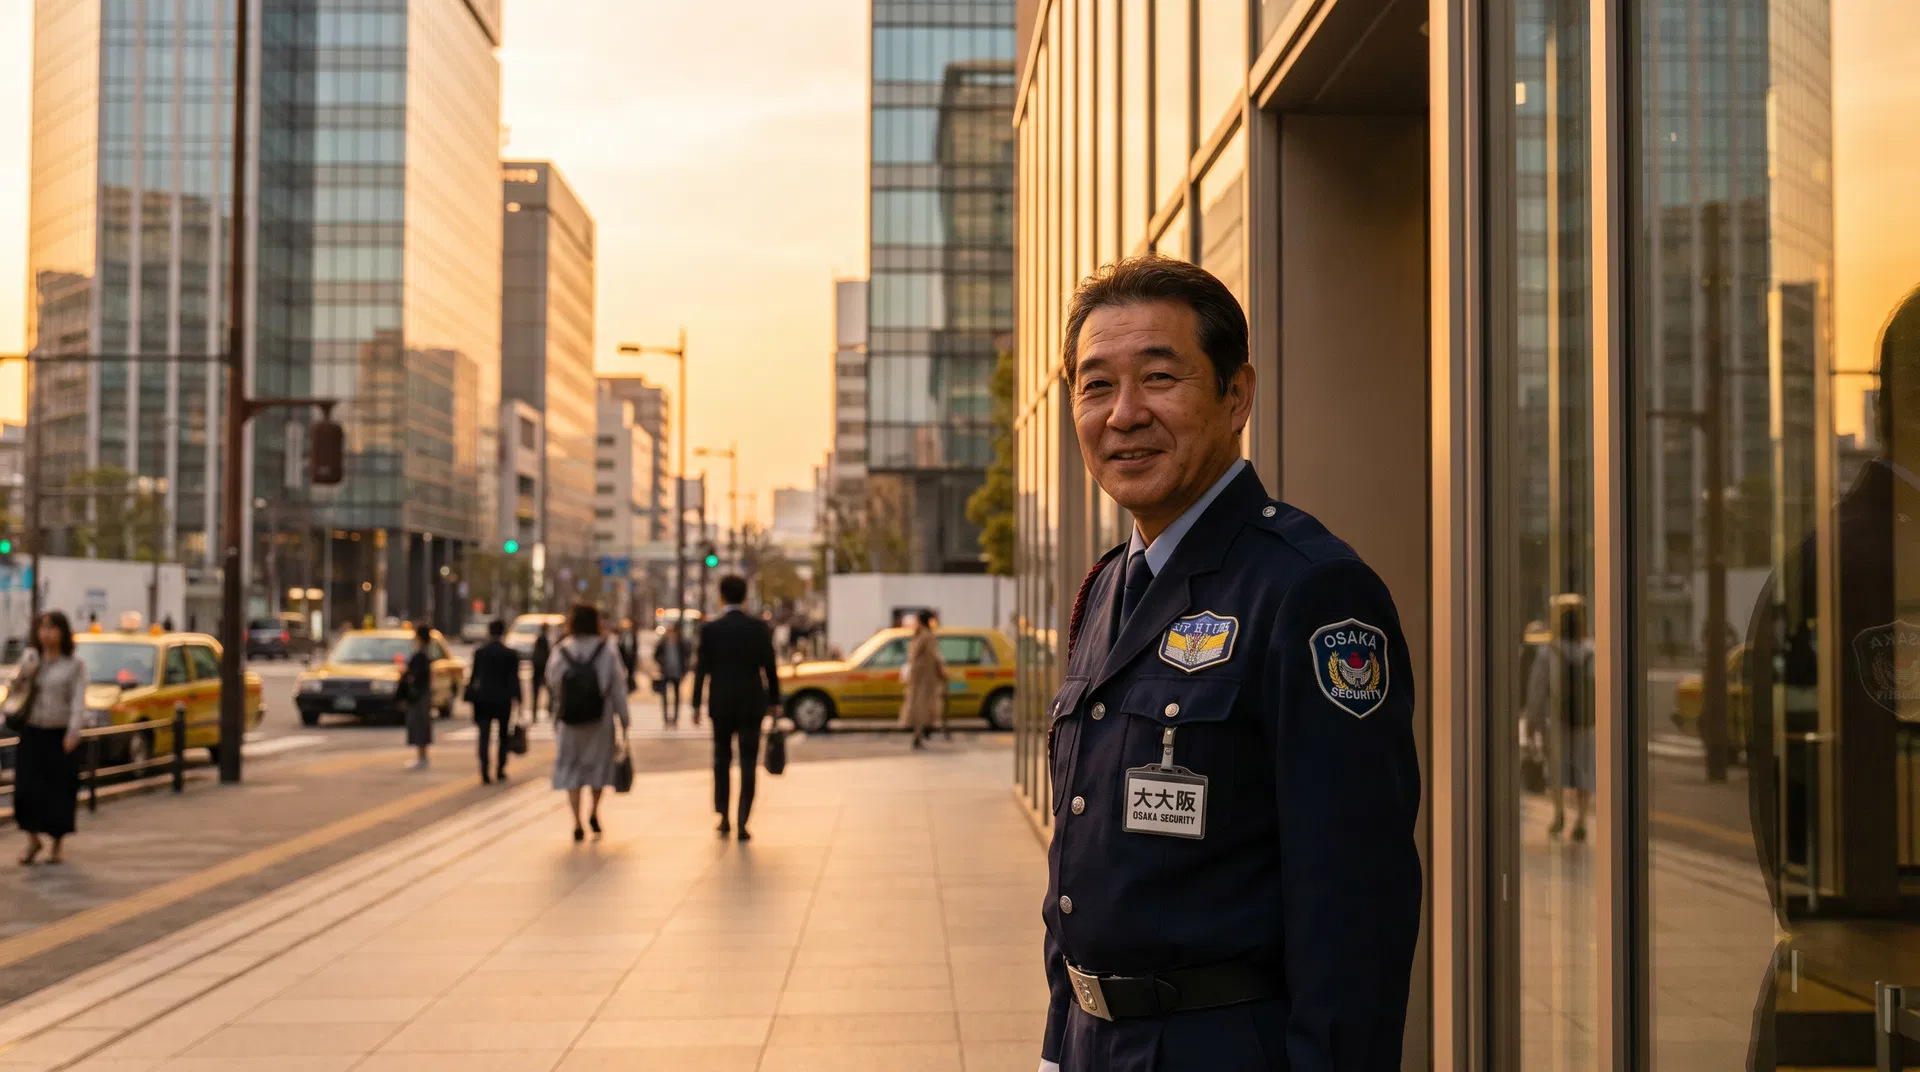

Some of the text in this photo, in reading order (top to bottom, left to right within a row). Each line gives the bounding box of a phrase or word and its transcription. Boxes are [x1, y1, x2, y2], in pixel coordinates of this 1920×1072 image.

[1324, 631, 1377, 650] OSAKA
[1330, 686, 1381, 700] SECURITY
[1133, 787, 1196, 812] 大大阪
[1133, 810, 1195, 825] OSAKA SECURITY
